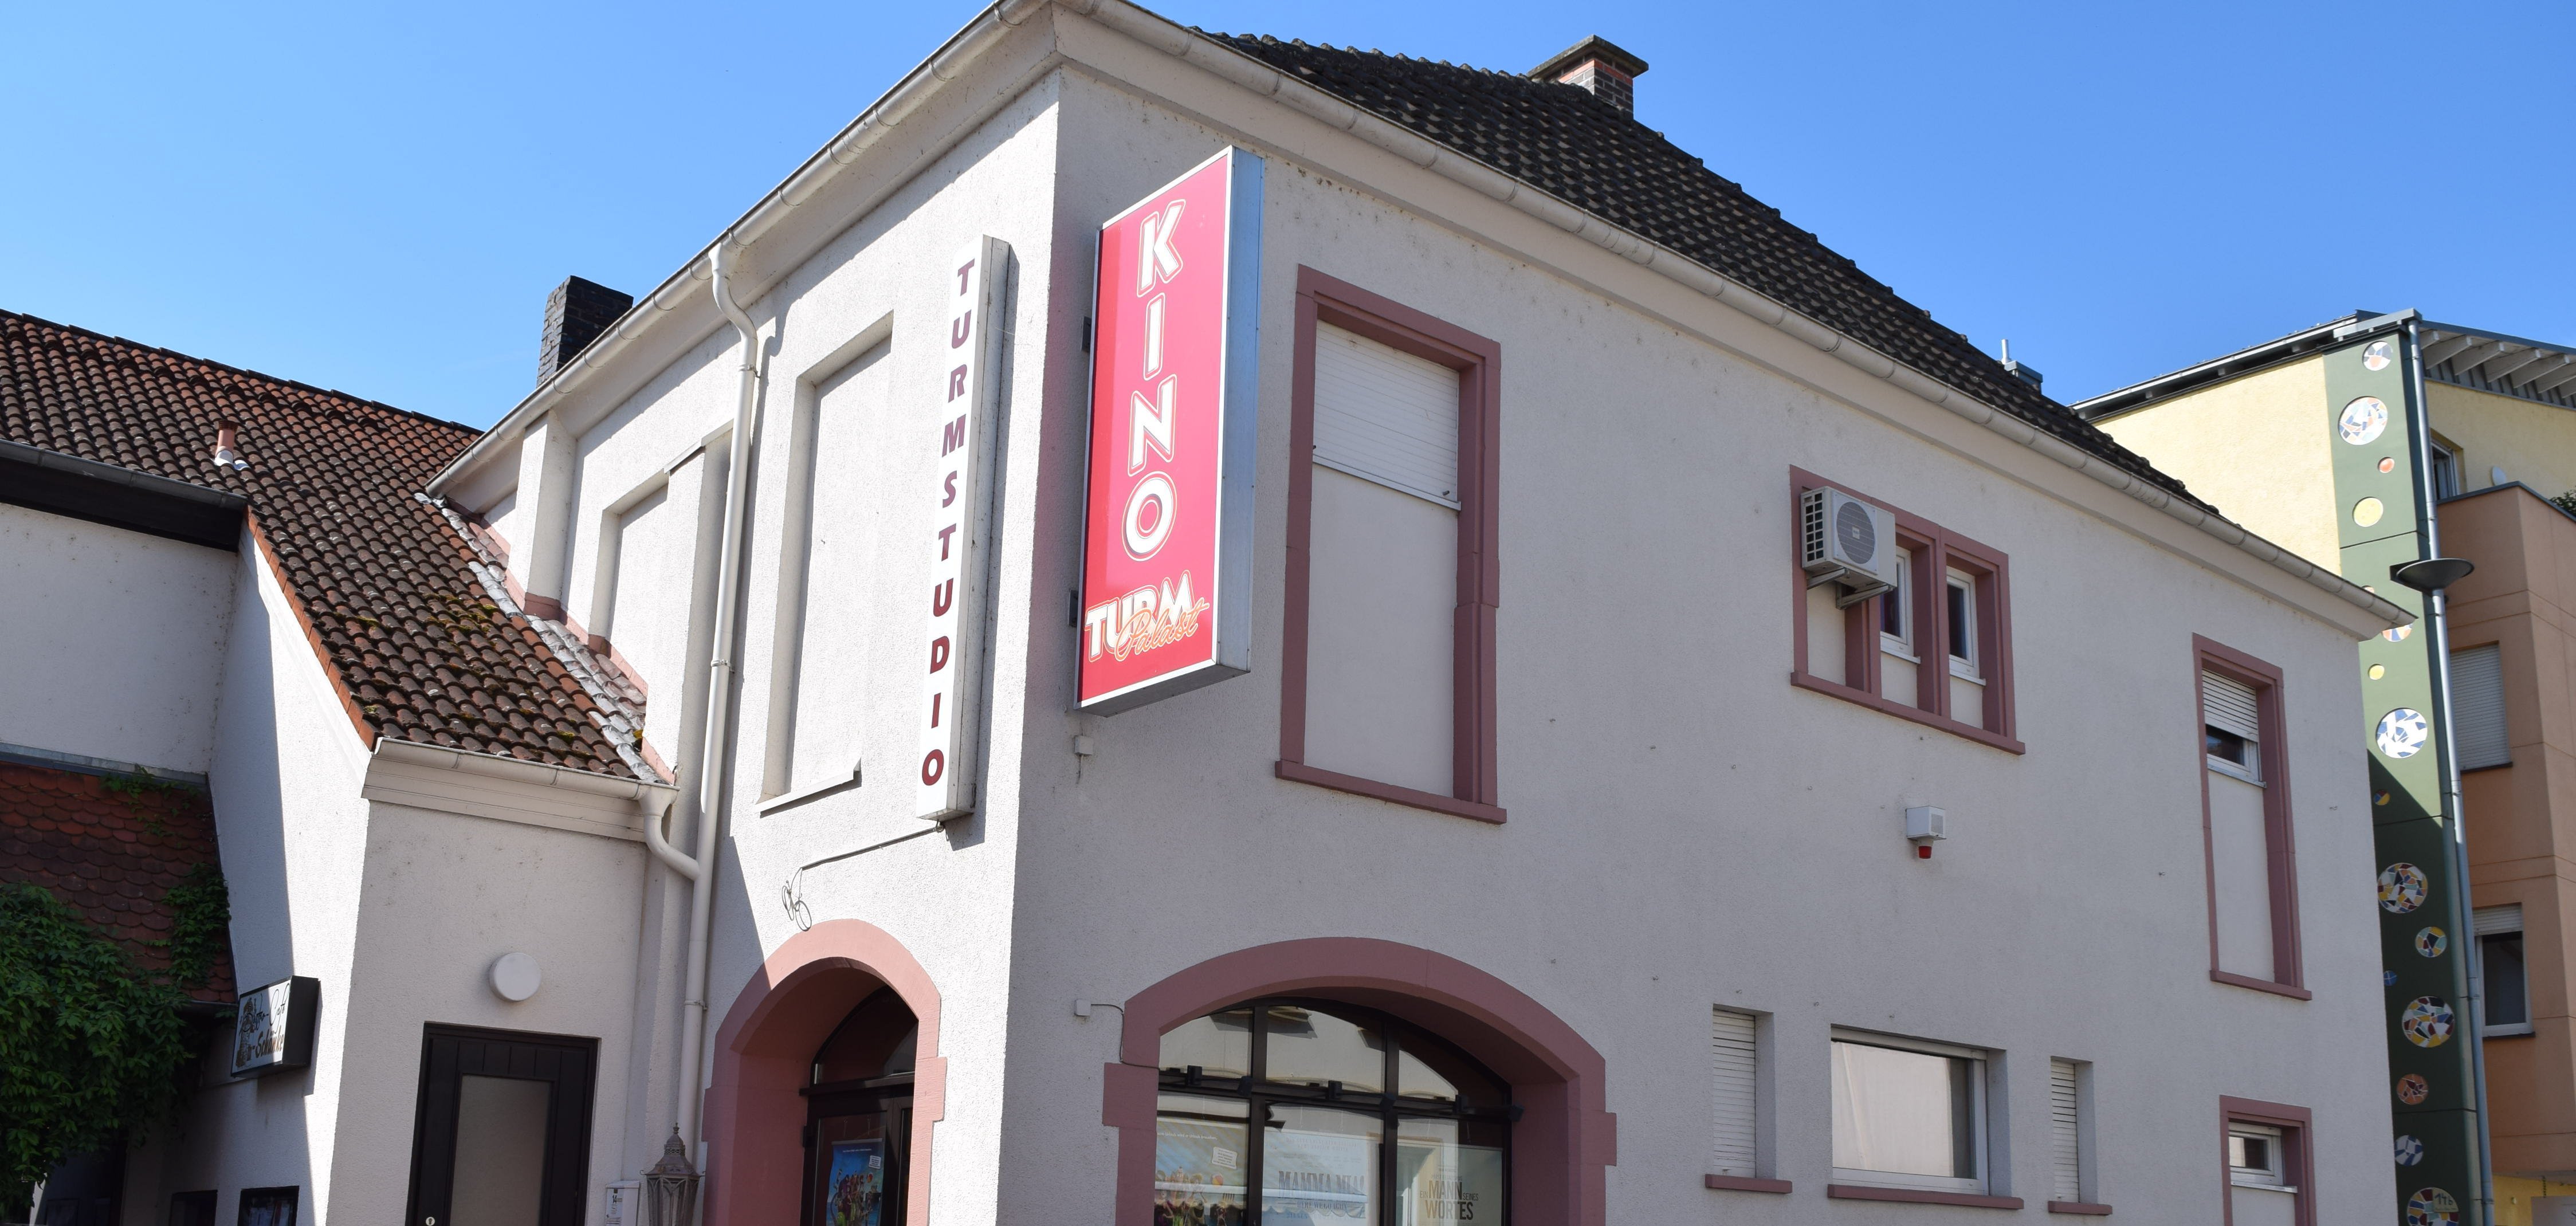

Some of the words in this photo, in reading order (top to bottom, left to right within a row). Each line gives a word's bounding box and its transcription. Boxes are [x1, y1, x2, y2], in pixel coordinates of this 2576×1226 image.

[1122, 199, 1185, 561] KINO
[921, 258, 975, 786] TURMSTUDIO
[1085, 571, 1194, 661] TURM
[1114, 598, 1210, 662] Palast
[1279, 1170, 1332, 1196] MAMMA
[1420, 1190, 1428, 1199] EIN
[1428, 1180, 1463, 1201] MANN
[1462, 1193, 1479, 1201] SEINES
[1425, 1200, 1474, 1220] WORTES
